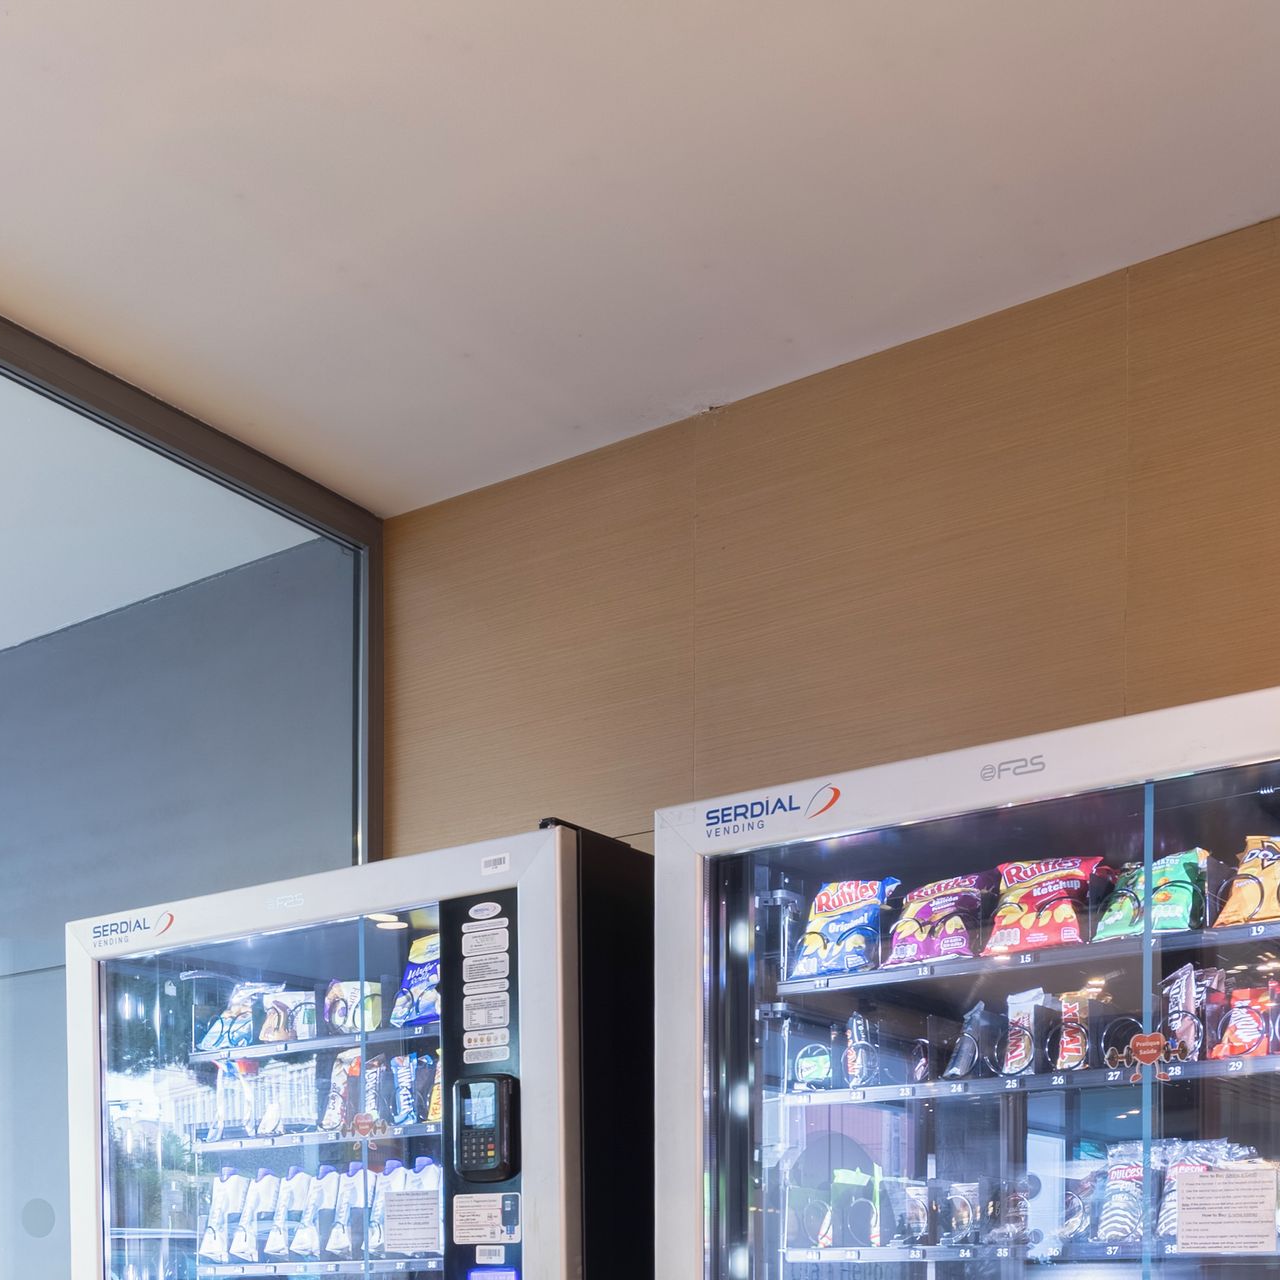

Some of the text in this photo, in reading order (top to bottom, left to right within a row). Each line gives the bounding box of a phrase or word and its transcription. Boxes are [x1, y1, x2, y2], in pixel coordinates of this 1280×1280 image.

[705, 794, 801, 827] SERDIAL
[706, 820, 766, 839] VENDING
[1004, 858, 1082, 888] Ruffles
[906, 875, 978, 902] Ruffles
[1033, 880, 1081, 896] Ketchup
[815, 880, 879, 913] Ruffles
[829, 914, 869, 933] Original
[92, 918, 150, 939] SERDIAL
[1251, 926, 1265, 935] 19
[93, 936, 129, 948] VENDING
[1020, 955, 1031, 963] 15
[918, 967, 928, 975] 13
[1169, 1067, 1181, 1075] 28
[1229, 1062, 1243, 1071] 29
[1052, 1076, 1064, 1085] 26
[1108, 1072, 1120, 1080] 27
[951, 1084, 962, 1092] 24
[1005, 1080, 1017, 1088] 25
[1110, 1166, 1144, 1180] DULCES
[960, 1249, 970, 1257] 34
[997, 1248, 1008, 1257] 35
[1048, 1248, 1059, 1256] 36
[1106, 1246, 1118, 1255] 37
[1165, 1245, 1177, 1254] 38
